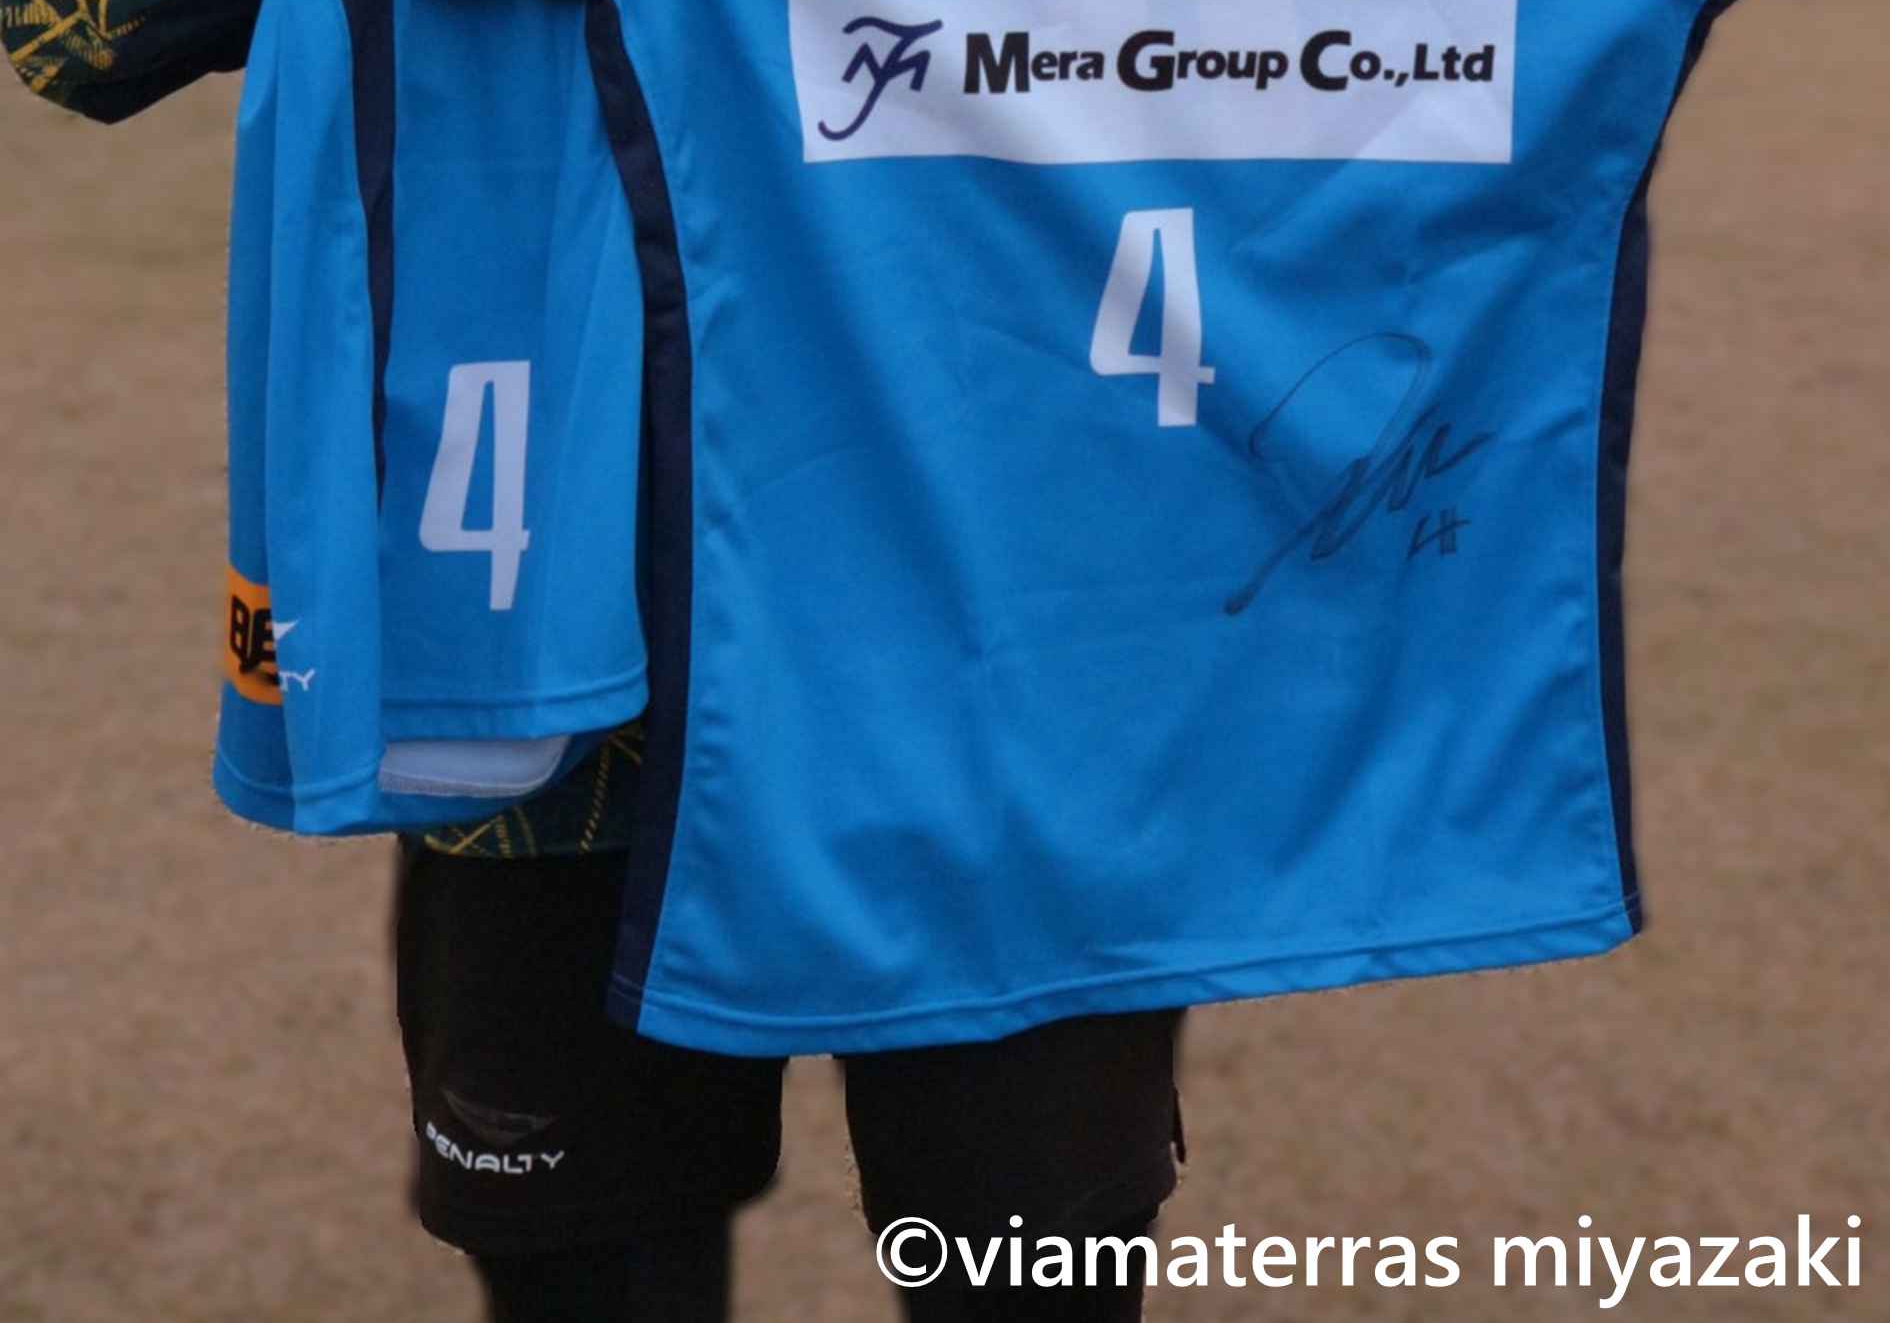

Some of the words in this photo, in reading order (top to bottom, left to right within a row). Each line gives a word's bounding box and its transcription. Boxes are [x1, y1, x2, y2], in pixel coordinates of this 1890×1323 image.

[963, 30, 1104, 95] Mera
[1116, 28, 1290, 92] Group
[1299, 28, 1495, 91] Co.,Ltd
[1089, 207, 1216, 428] 4
[418, 360, 532, 611] 4
